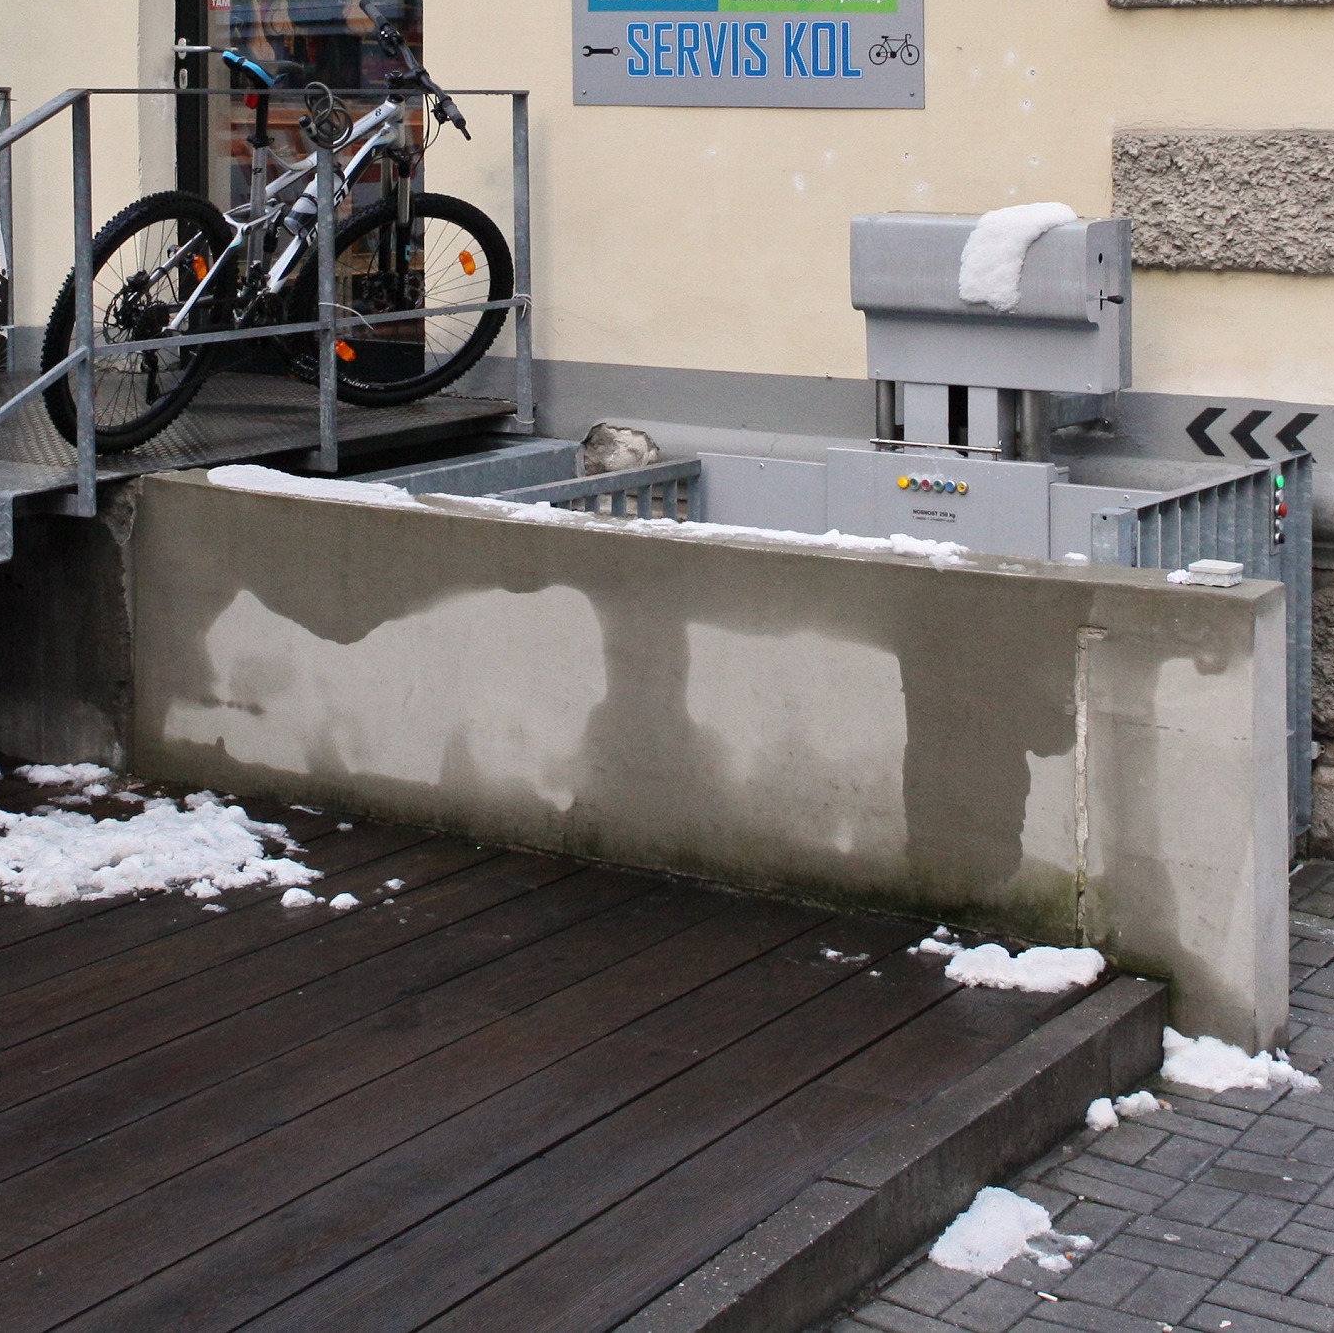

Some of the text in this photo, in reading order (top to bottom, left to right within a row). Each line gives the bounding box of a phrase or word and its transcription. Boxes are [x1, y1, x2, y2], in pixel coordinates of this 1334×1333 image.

[626, 20, 863, 78] SERVIS KOL
[913, 509, 938, 517] NOSNOST
